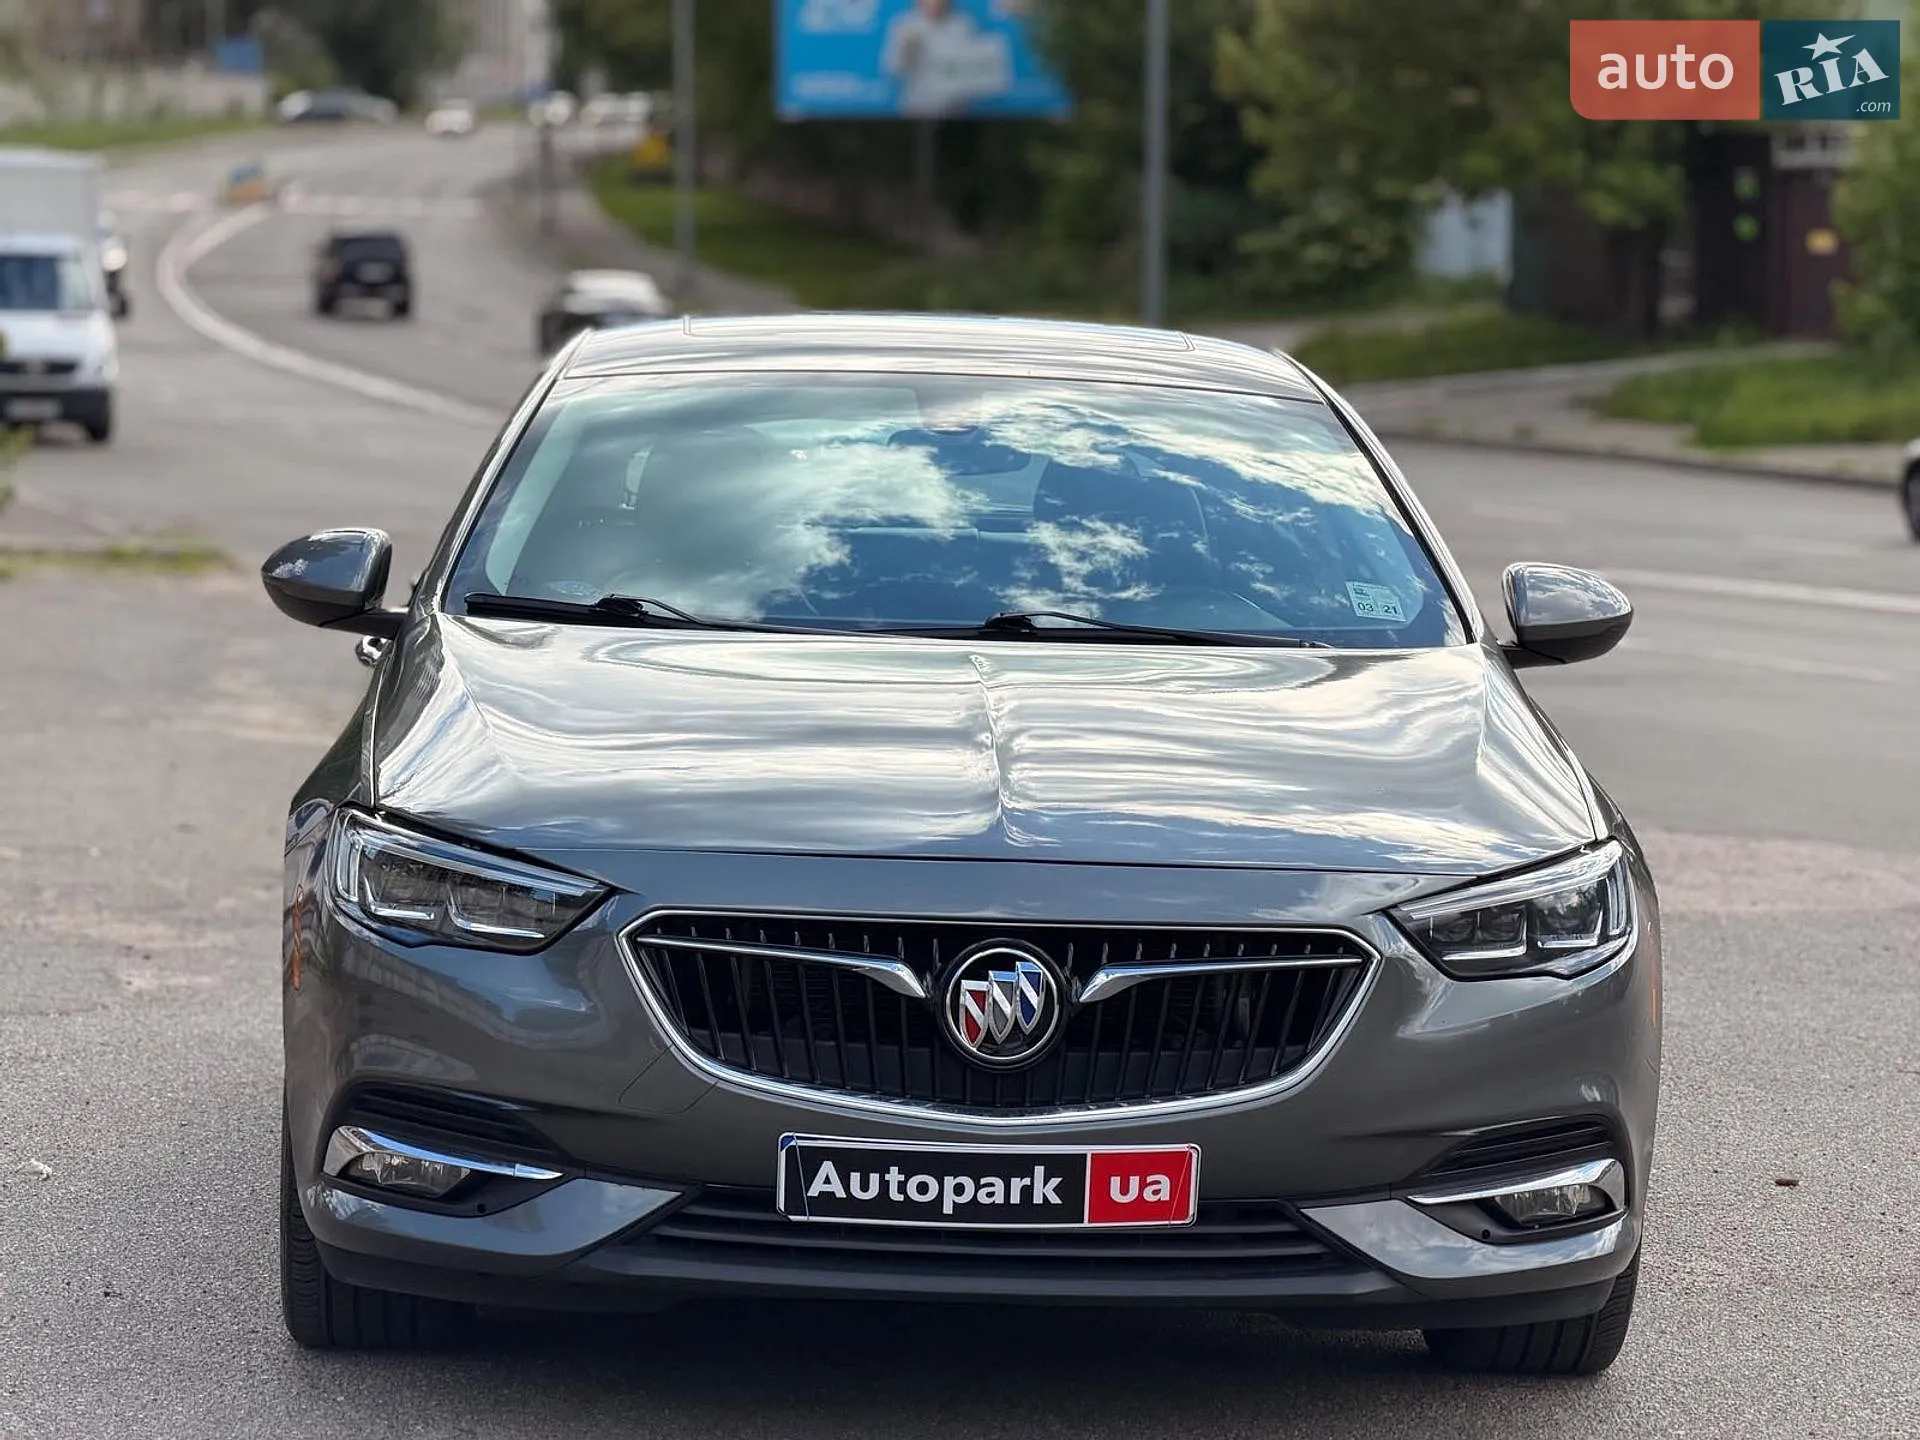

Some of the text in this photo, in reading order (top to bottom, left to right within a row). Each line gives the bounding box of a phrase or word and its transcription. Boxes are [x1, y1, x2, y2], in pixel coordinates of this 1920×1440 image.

[1357, 602, 1398, 615] 03 21
[807, 1160, 1171, 1214] Autopark ua
